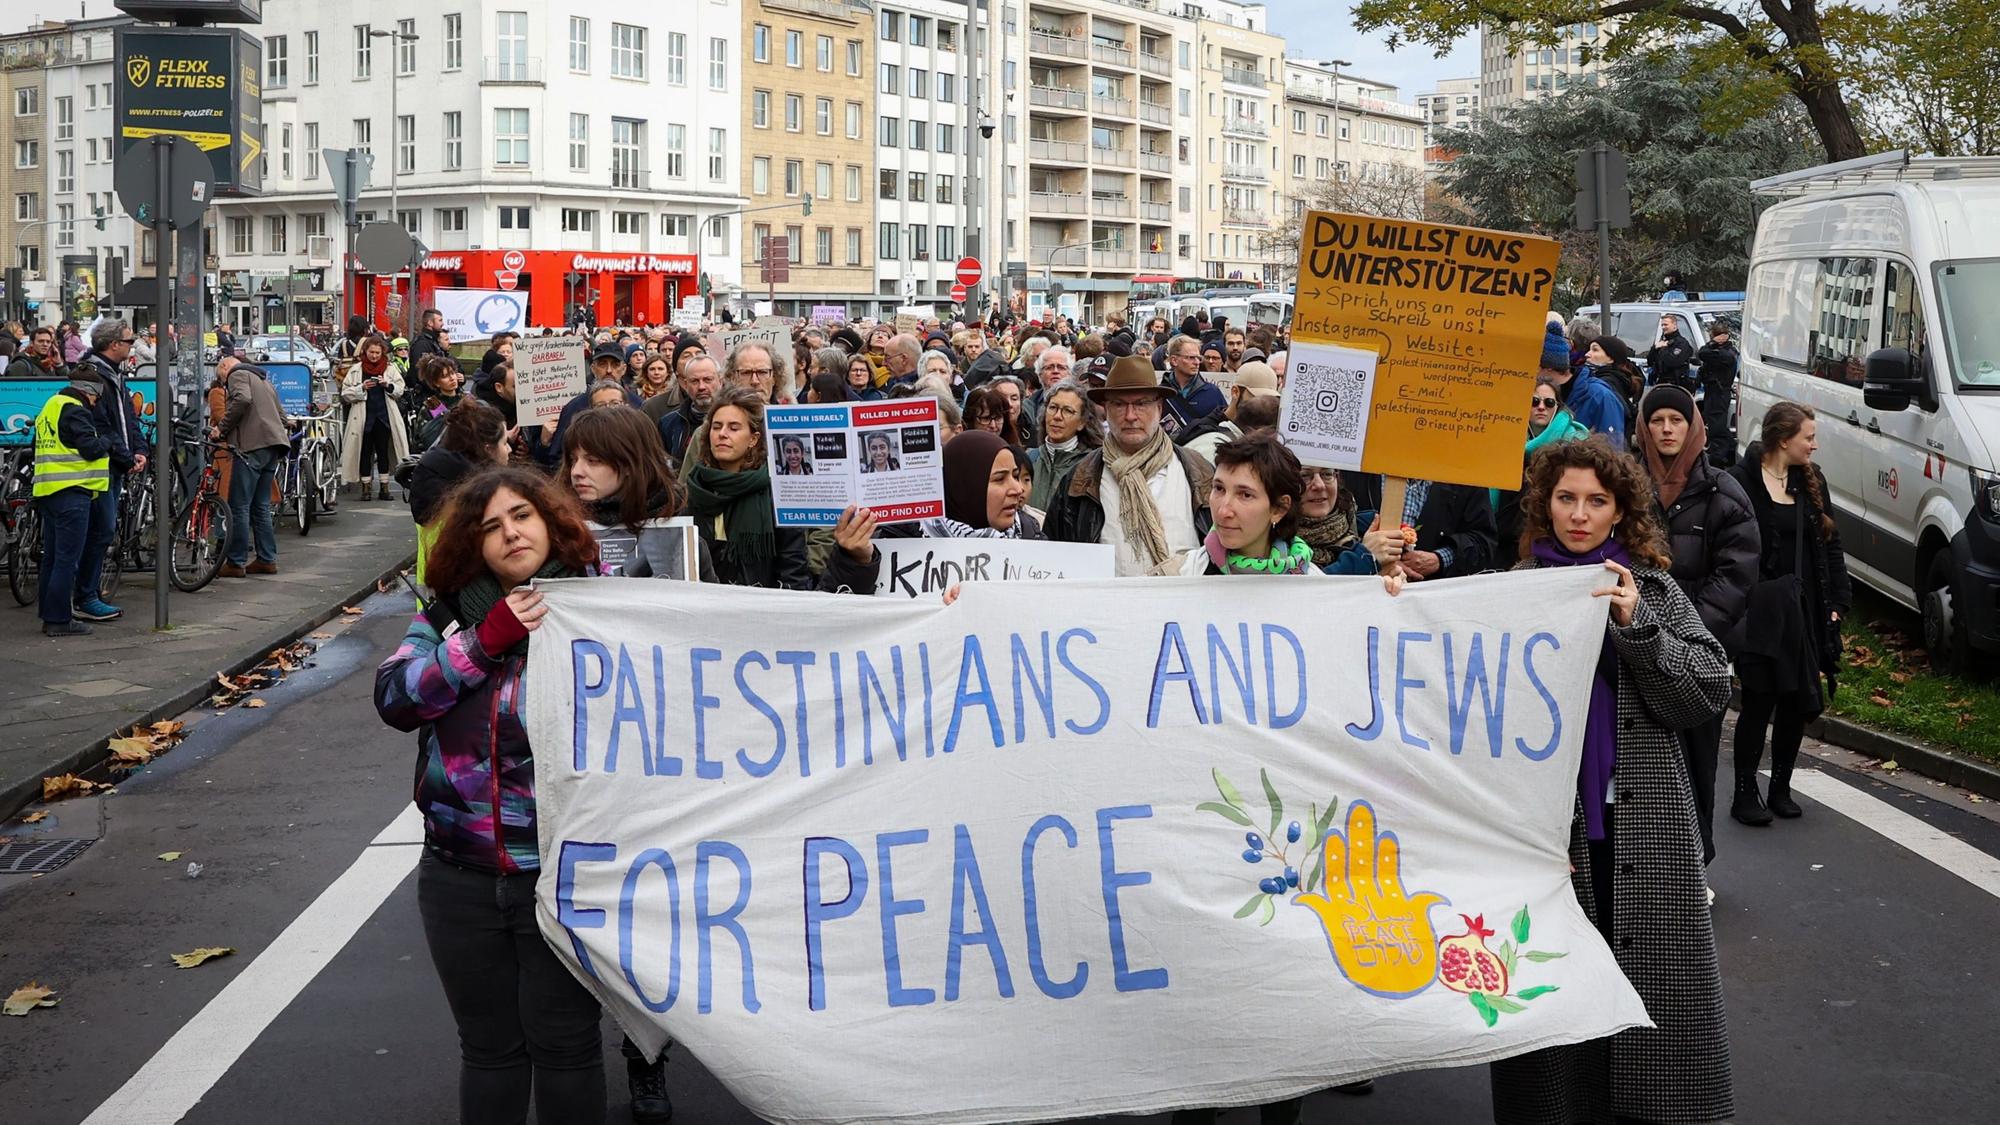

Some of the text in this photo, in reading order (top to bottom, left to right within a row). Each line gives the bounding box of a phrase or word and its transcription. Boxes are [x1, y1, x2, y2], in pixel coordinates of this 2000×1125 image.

[158, 59, 209, 73] FLEXX
[156, 75, 226, 89] FITNESS
[129, 108, 224, 118] WWW.FITNESS-POLIZEI.DE
[1313, 216, 1525, 265] DU WILLST UNS
[421, 256, 463, 271] ommes
[572, 254, 693, 273] Currywurst & Pommes
[1309, 249, 1552, 303] UNTERSTÜTZEN?
[1326, 286, 1506, 320] Sprich uns an oder
[1296, 313, 1378, 340] Instagram
[1443, 318, 1486, 335] uns!
[771, 415, 799, 423] KILLED
[811, 414, 844, 422] ISRAEL?
[860, 411, 890, 419] KILLED
[902, 408, 930, 416] GAZA?
[1414, 416, 1487, 439] @riseup.net
[783, 512, 806, 521] TEAR
[808, 512, 822, 521] ME
[891, 507, 913, 516] FIND
[915, 505, 935, 514] OUT
[571, 622, 1562, 780] PALESTINIANS AND JEWS
[555, 804, 1170, 1014] FOR PEACE
[1347, 924, 1418, 943] PEACE
